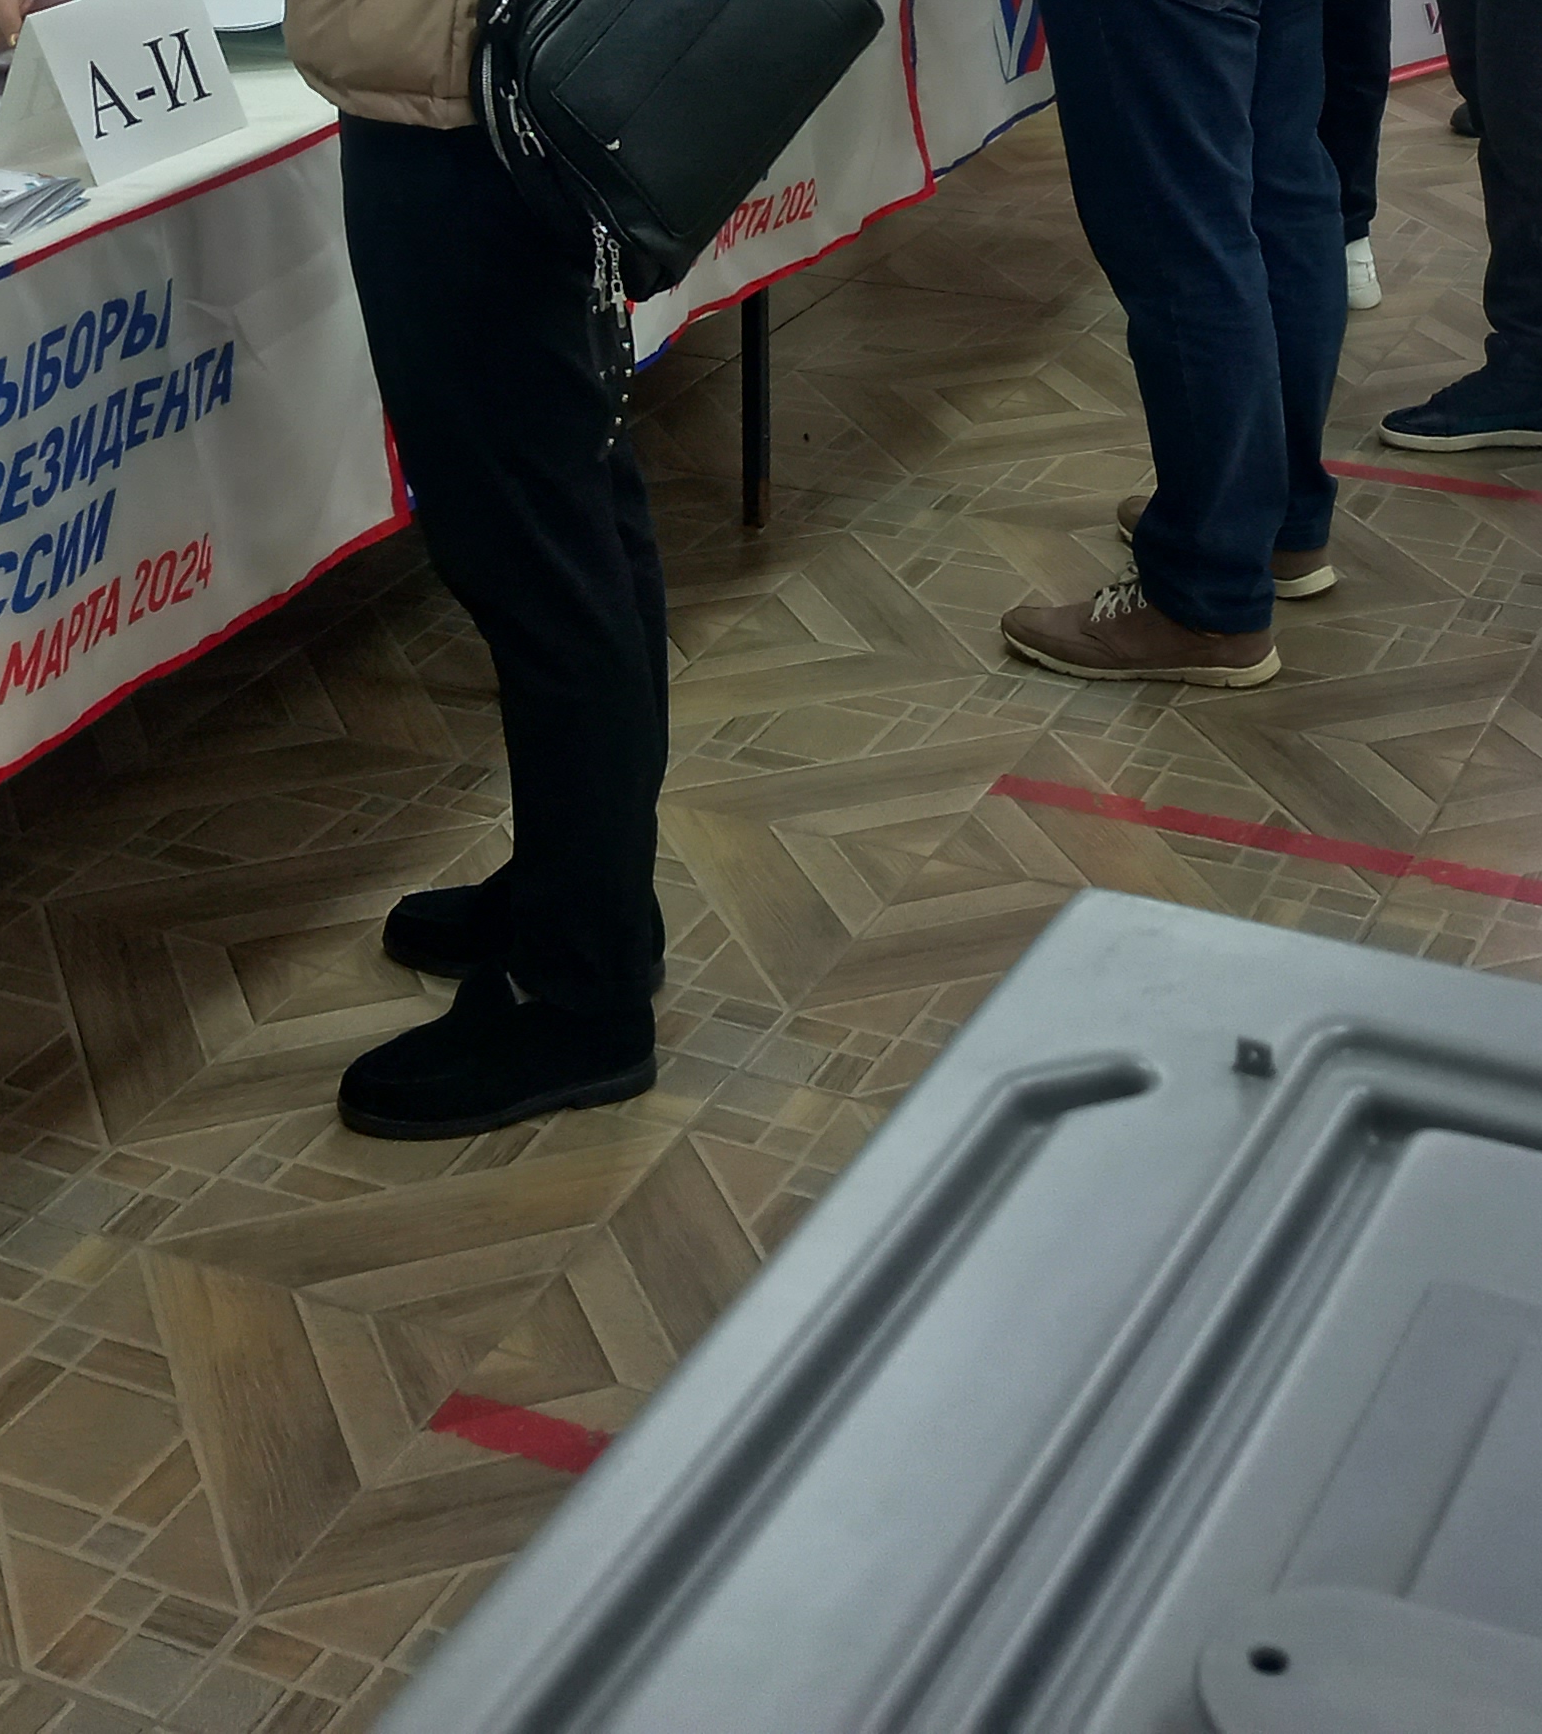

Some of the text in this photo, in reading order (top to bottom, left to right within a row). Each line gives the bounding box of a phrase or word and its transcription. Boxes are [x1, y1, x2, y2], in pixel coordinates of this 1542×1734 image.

[88, 26, 214, 140] А-И
[773, 177, 818, 231] 202
[127, 531, 214, 627] 2024
